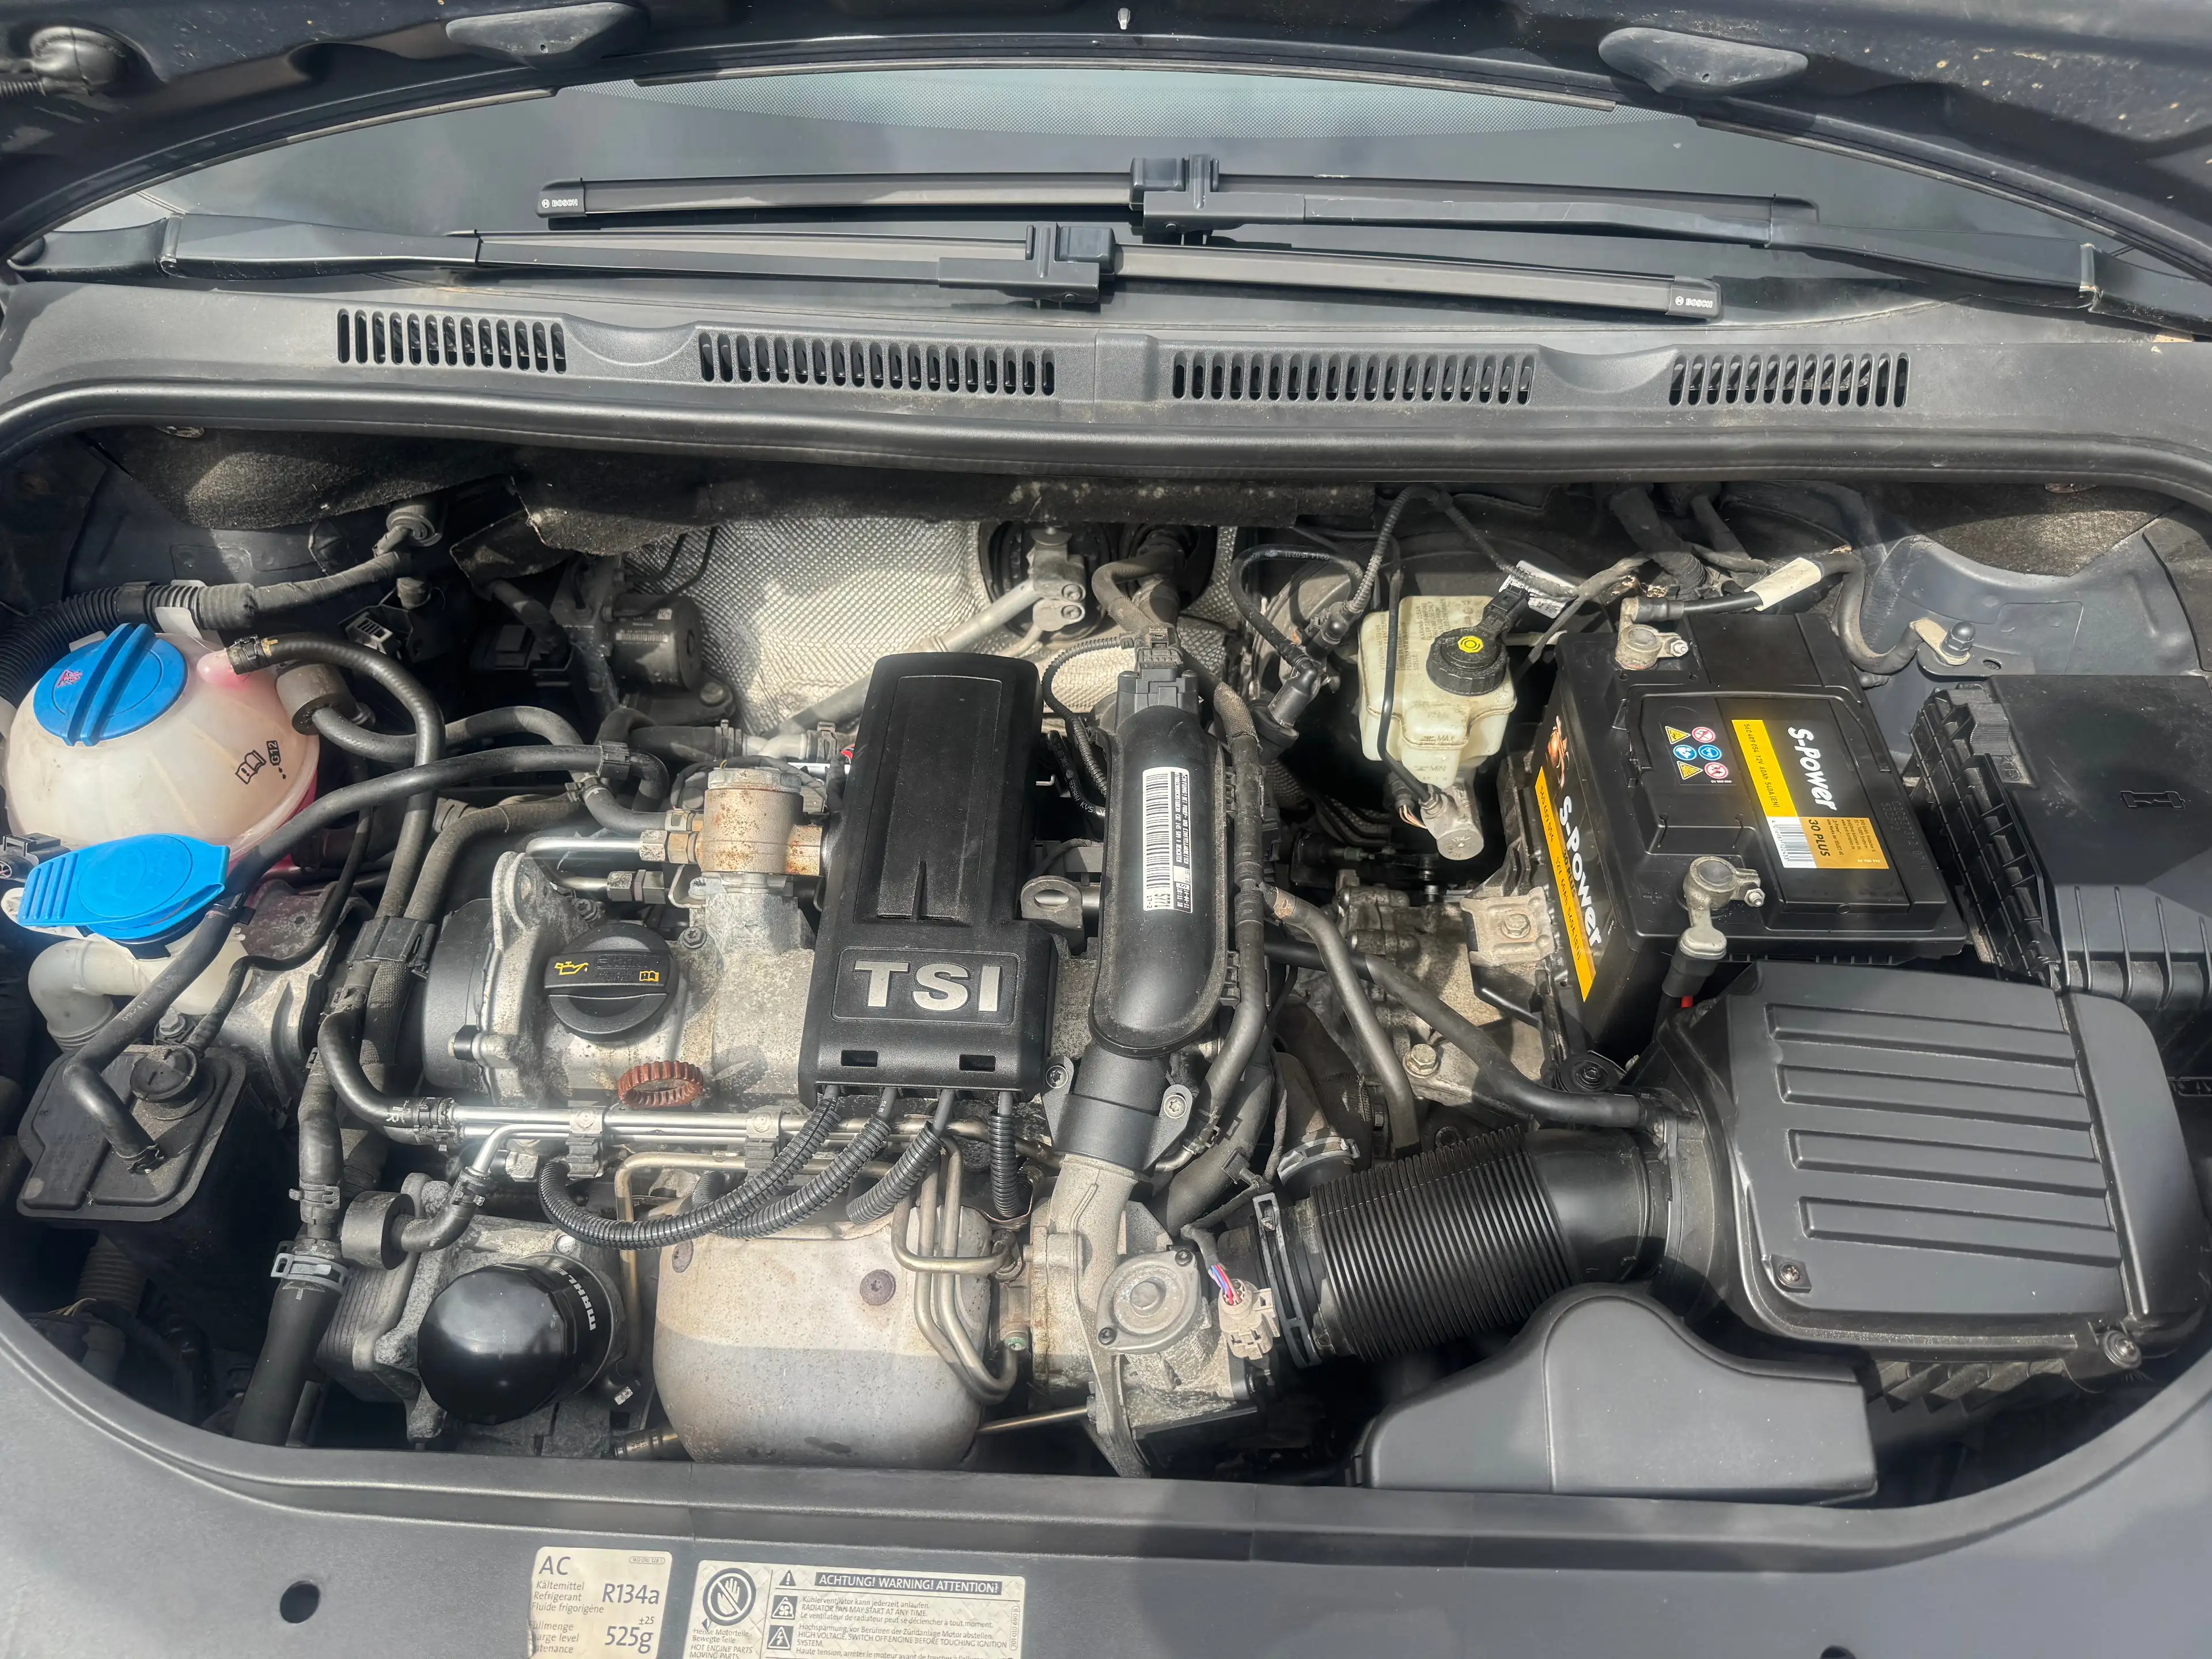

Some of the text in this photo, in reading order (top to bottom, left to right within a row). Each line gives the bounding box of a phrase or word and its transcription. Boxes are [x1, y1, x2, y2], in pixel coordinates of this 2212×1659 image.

[552, 199, 578, 207] BOSCH
[1685, 298, 1713, 308] BOSCH
[268, 741, 279, 763] G12
[1751, 743, 1760, 753] 054
[1756, 755, 1764, 764] 12V
[1759, 766, 1769, 780] 60Ah
[1787, 727, 1837, 810] S-Power
[1765, 781, 1774, 796] 540A
[1808, 819, 1831, 857] 30 PLUS
[1559, 796, 1601, 946] S-Power
[854, 961, 1001, 1012] TSI
[553, 1267, 596, 1331] MAHLE
[539, 1555, 571, 1575] AC
[536, 1581, 584, 1591] Kältemittel
[819, 1574, 998, 1593] ACHTUNG! WARNING! ATTENTION!
[534, 1592, 582, 1603] Refrigerant
[602, 1583, 660, 1604] R134a
[803, 1596, 853, 1605] Kühlerventilator
[855, 1598, 870, 1606] kann
[532, 1602, 604, 1615] Fluide frigorigène
[639, 1616, 654, 1624] ±25
[908, 1617, 943, 1625] déclencher
[559, 1633, 579, 1642] level
[800, 1623, 849, 1634] Hochspannung,
[861, 1626, 890, 1634] Berühren
[903, 1628, 941, 1638] Zündanlage
[963, 1631, 994, 1639] abstellen.
[605, 1626, 653, 1654] 525g
[692, 1635, 720, 1643] Bewegte
[797, 1639, 824, 1647] SYSTEM.
[817, 1633, 847, 1641] VOLTAGE,
[940, 1638, 975, 1646] TOUCHING
[818, 1649, 843, 1657] tension,
